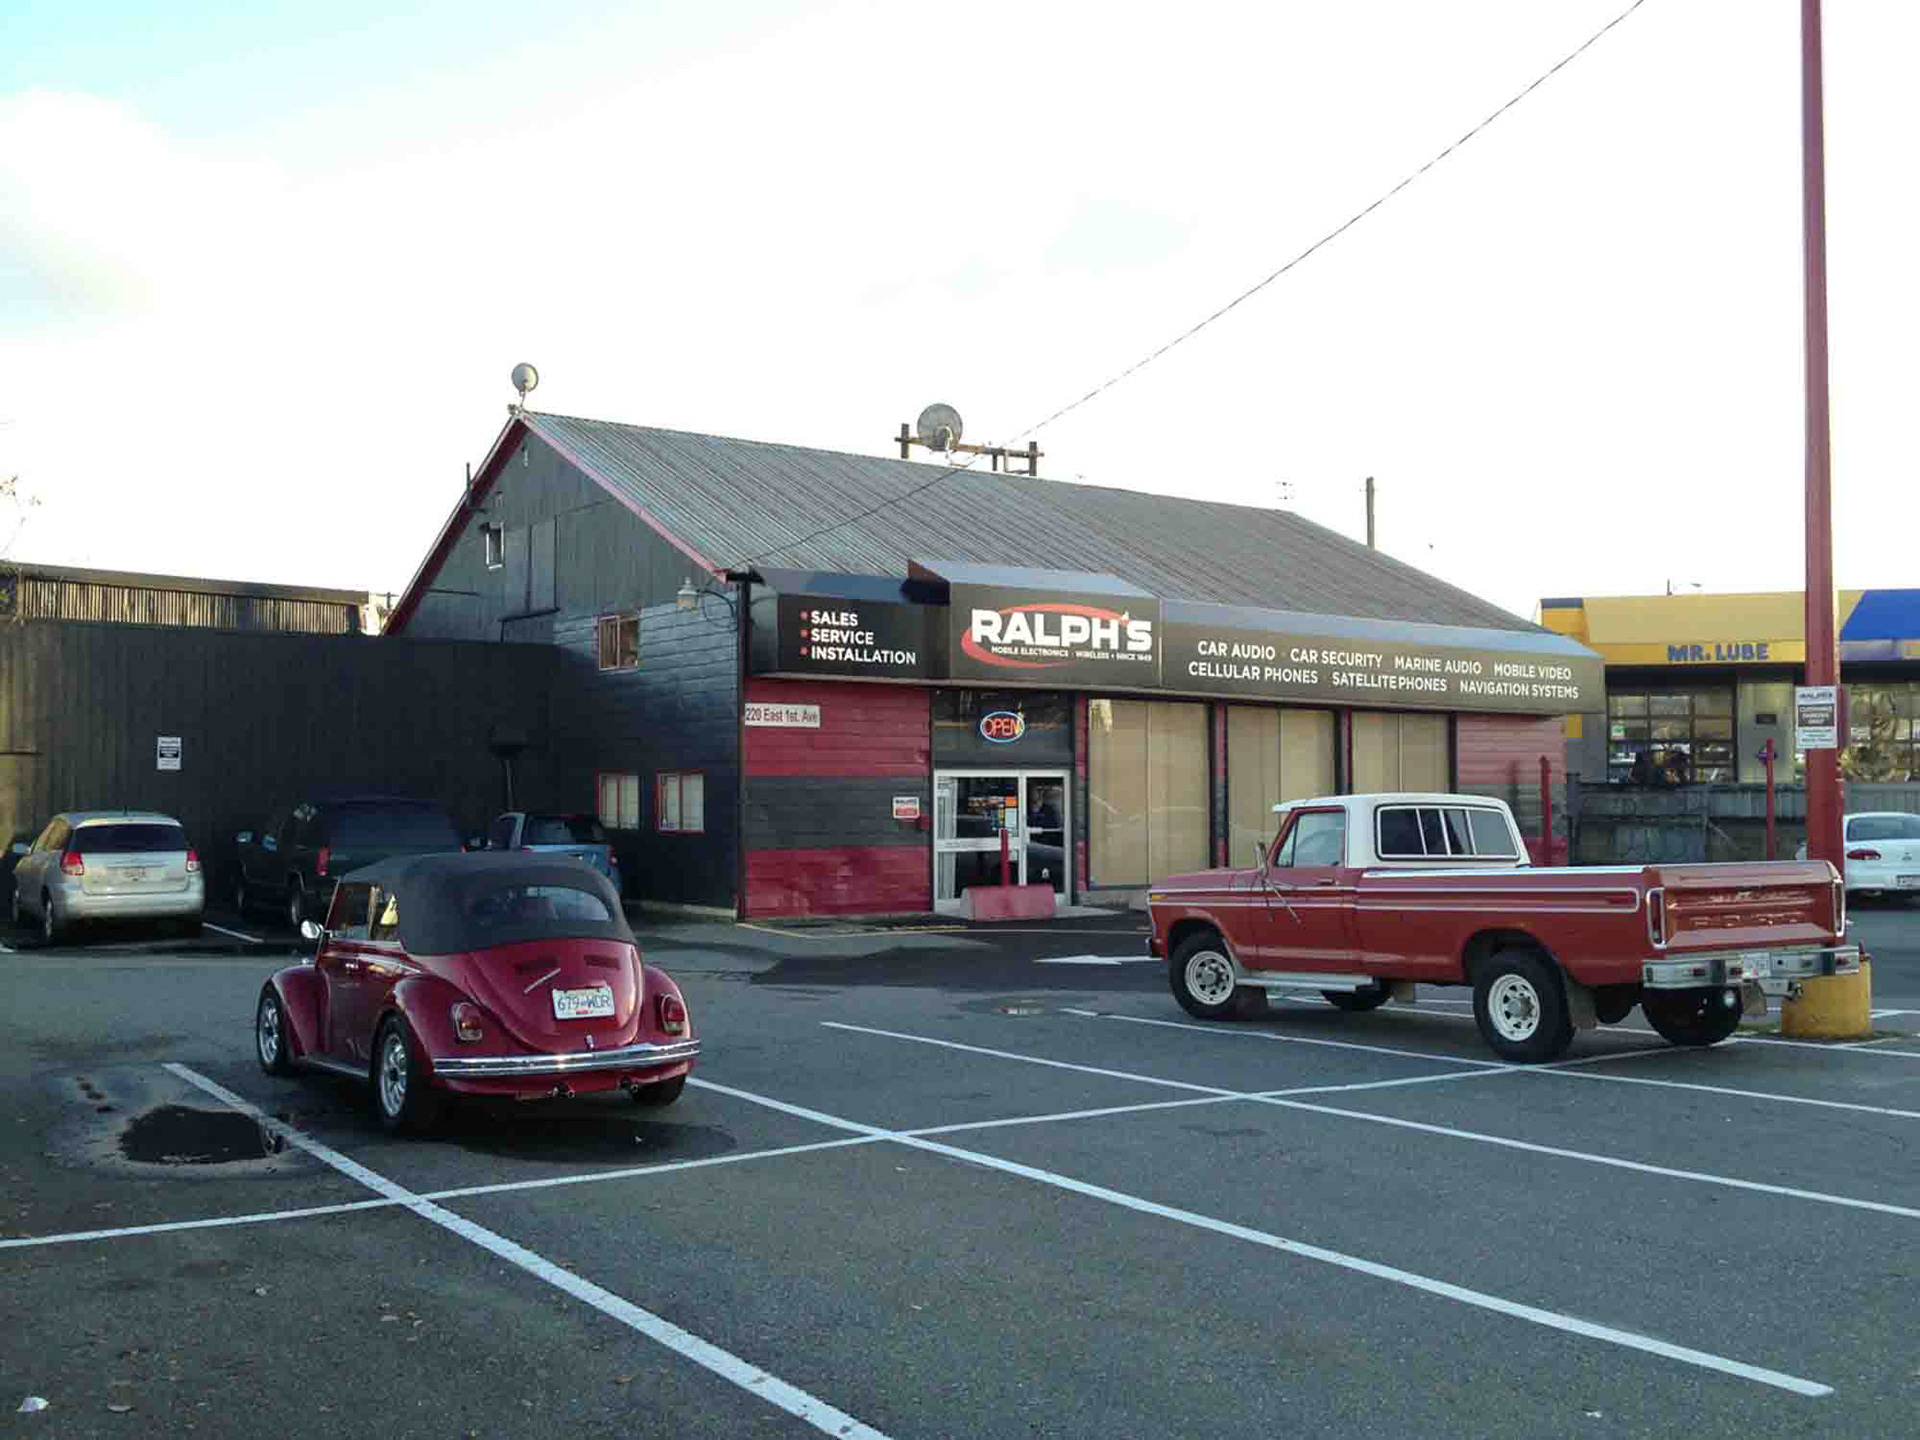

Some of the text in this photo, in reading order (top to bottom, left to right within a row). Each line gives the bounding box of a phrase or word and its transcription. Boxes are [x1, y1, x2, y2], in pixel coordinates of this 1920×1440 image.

[811, 610, 858, 626] SALES
[811, 628, 874, 645] SERVICE
[971, 608, 1153, 652] RALPH'S
[811, 645, 916, 665] INSTALLATION
[991, 645, 1019, 656] MOBILE
[1020, 647, 1069, 658] ELECTRONICS
[1667, 644, 1769, 661] MR. LUBE
[1197, 641, 1572, 680] CAR AUDIO CAR SECURITY MARINE AUDIO MOBILE VIDEO
[1188, 661, 1580, 700] CELLULAR PHONES SATELLITE PHONES NAVIGATION SYSTEMS
[763, 708, 783, 723] East
[983, 718, 1021, 736] OPEN
